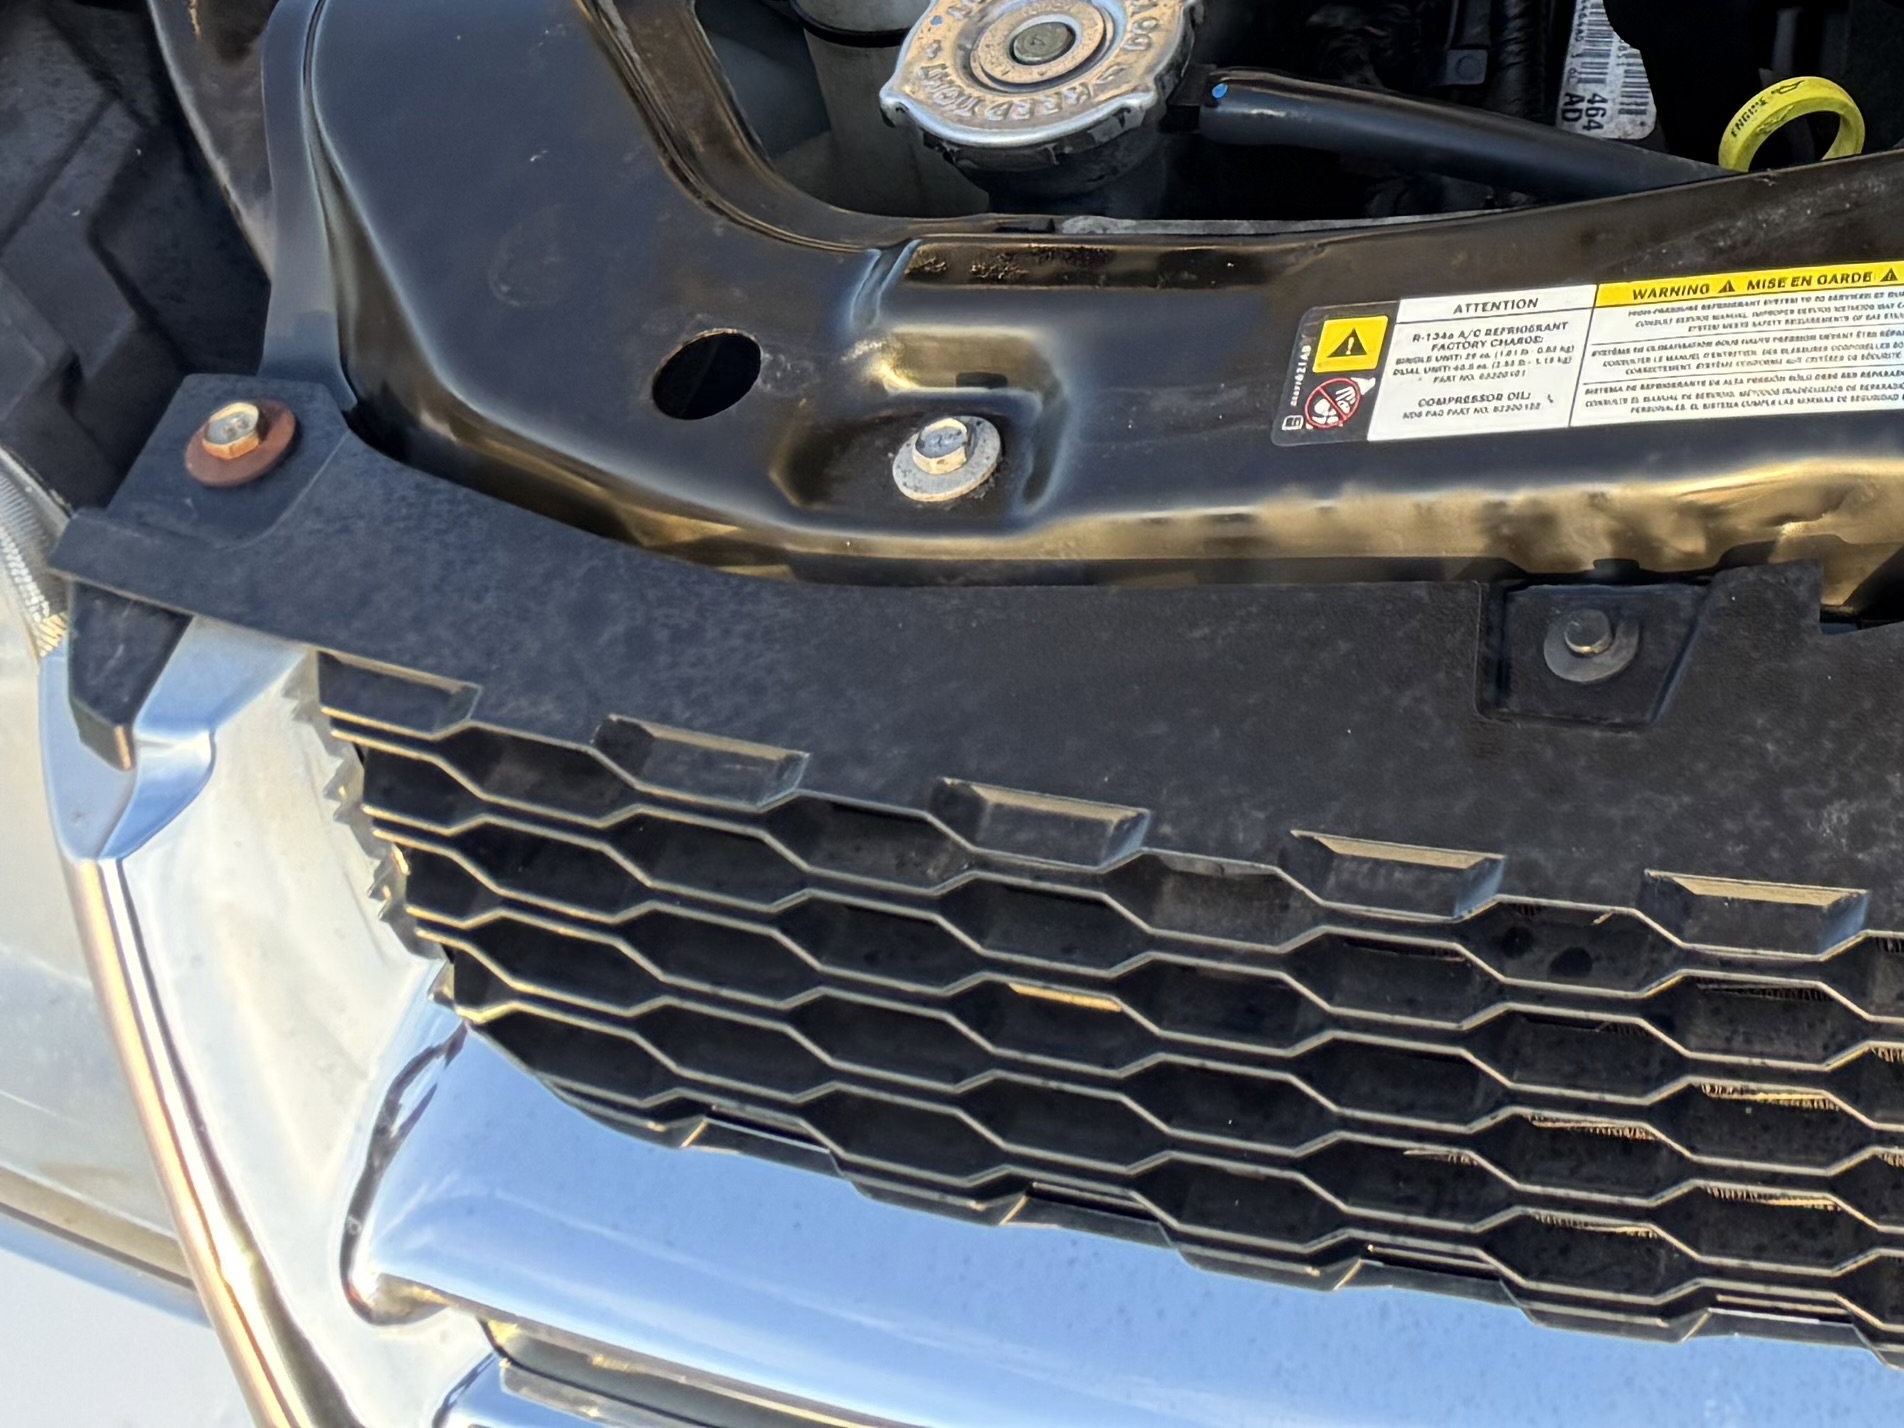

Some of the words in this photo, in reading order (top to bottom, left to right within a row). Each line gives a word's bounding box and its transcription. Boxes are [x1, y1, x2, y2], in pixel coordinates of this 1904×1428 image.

[1561, 92, 1586, 123] AD
[1582, 92, 1608, 132] 464
[1453, 297, 1539, 314] ATTENTION
[1632, 283, 1711, 301] WARNING
[1746, 277, 1786, 291] MISE
[1790, 275, 1813, 288] EN
[1817, 271, 1873, 285] GARDE
